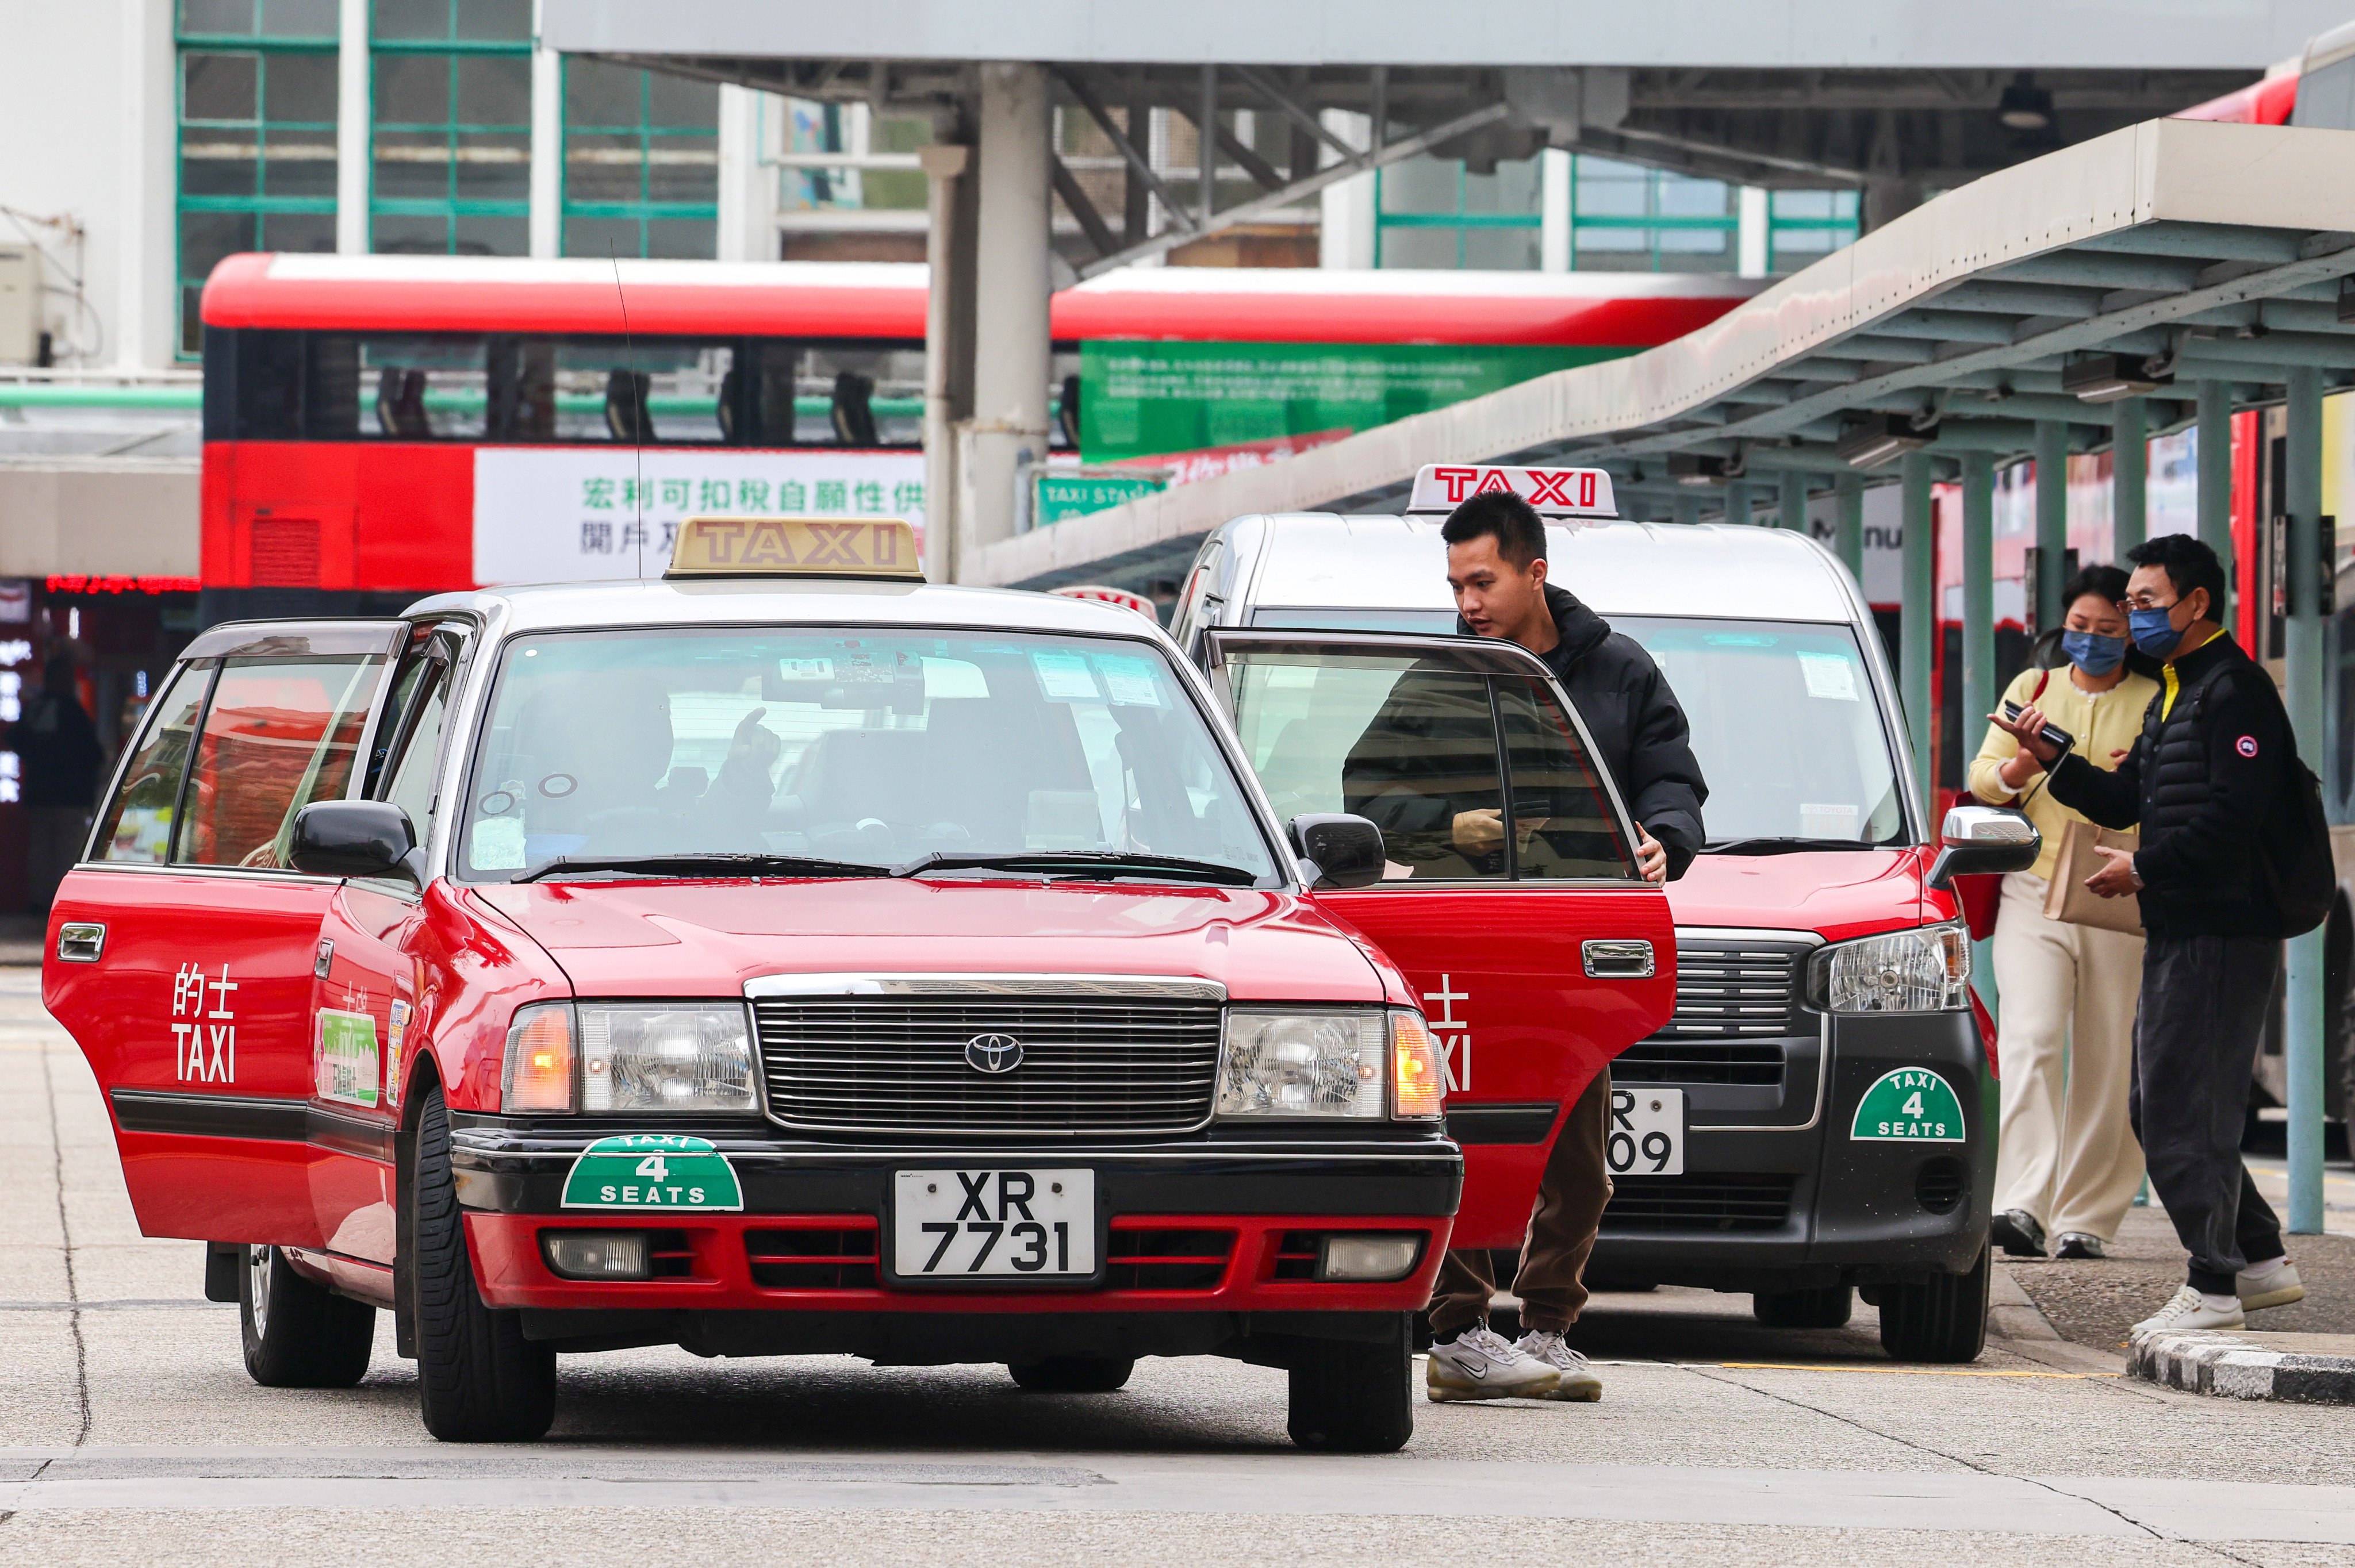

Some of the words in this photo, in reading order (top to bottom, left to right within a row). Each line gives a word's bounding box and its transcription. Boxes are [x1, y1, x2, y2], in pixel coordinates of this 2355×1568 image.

[1046, 486, 1087, 504] TAXI
[1435, 468, 1596, 507] TAXI
[696, 522, 897, 566] TAXI
[1820, 806, 1853, 814] TOYOTA
[172, 962, 239, 1020] 的士
[171, 1023, 235, 1083] TAXI
[1889, 1072, 1937, 1092] TAXI
[1901, 1091, 1924, 1119] 4
[619, 1135, 690, 1149] TAXI
[1877, 1121, 1946, 1137] SEATS
[635, 1149, 669, 1182] 4
[1606, 1131, 1672, 1173] 09
[600, 1185, 706, 1204] SEATS
[955, 1171, 1035, 1221] XR
[921, 1221, 1069, 1273] 7731
